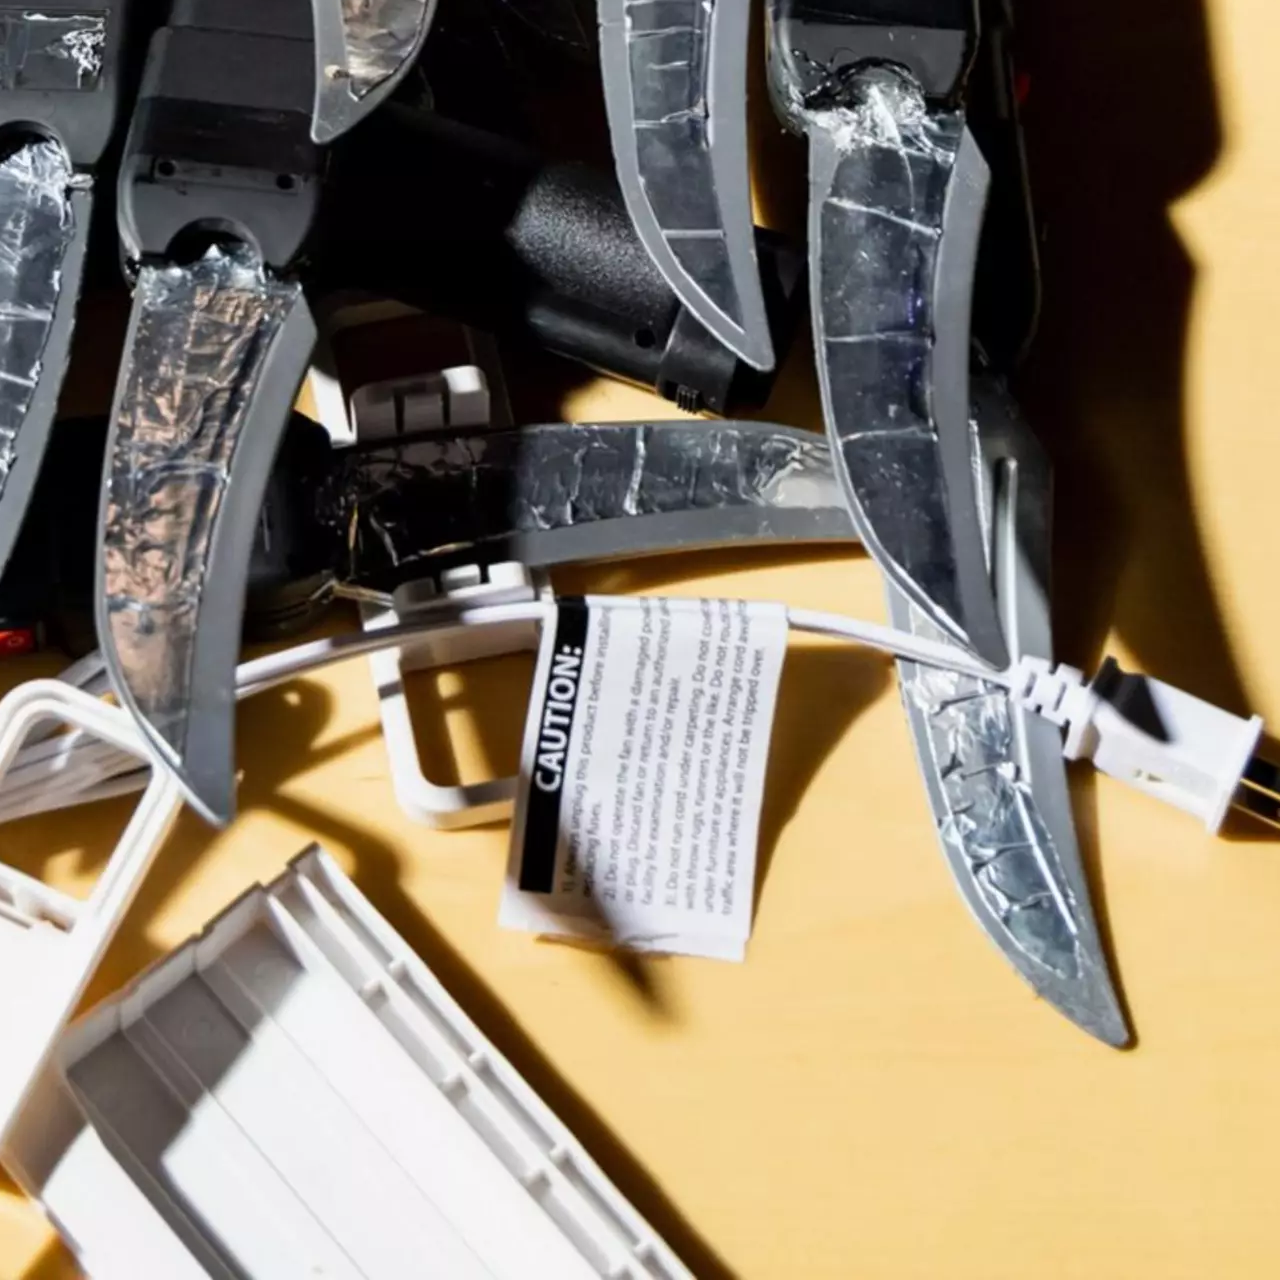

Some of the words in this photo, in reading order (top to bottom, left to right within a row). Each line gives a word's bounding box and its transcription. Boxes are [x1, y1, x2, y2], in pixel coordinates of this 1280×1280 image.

[651, 619, 671, 687] authorized
[696, 640, 709, 661] not
[714, 645, 727, 667] not
[731, 645, 746, 674] cord
[630, 636, 651, 696] damaged
[692, 664, 707, 683] Do
[709, 669, 724, 688] Do
[587, 661, 604, 702] before
[649, 689, 660, 705] an
[722, 676, 743, 726] Arrange
[741, 679, 760, 725] tripped
[535, 645, 584, 793] CAUTION:
[623, 709, 637, 736] with
[645, 707, 657, 721] to
[580, 705, 597, 755] product
[703, 718, 716, 739] the
[738, 729, 751, 744] be
[618, 740, 632, 760] fan
[639, 723, 654, 763] return
[701, 741, 712, 756] or
[575, 758, 588, 780] this
[677, 751, 691, 788] under
[736, 747, 749, 769] not
[616, 762, 629, 783] the
[637, 765, 646, 779] or
[694, 759, 710, 807] runners
[732, 772, 745, 793] will
[632, 782, 645, 801] fan
[647, 762, 666, 841] examination
[571, 783, 588, 829] unplug
[610, 787, 627, 836] operate
[673, 791, 688, 820] cord
[712, 802, 722, 815] or
[626, 804, 643, 852] Discard
[726, 808, 741, 847] where
[608, 839, 620, 860] not
[644, 843, 657, 861] for
[668, 847, 681, 869] not
[705, 819, 721, 873] furniture
[605, 864, 618, 881] Do
[686, 843, 699, 879] throw
[723, 850, 736, 877] area
[639, 863, 657, 905] facility
[665, 871, 679, 890] Do
[701, 876, 716, 912] under
[624, 890, 634, 903] or
[682, 883, 696, 910] with
